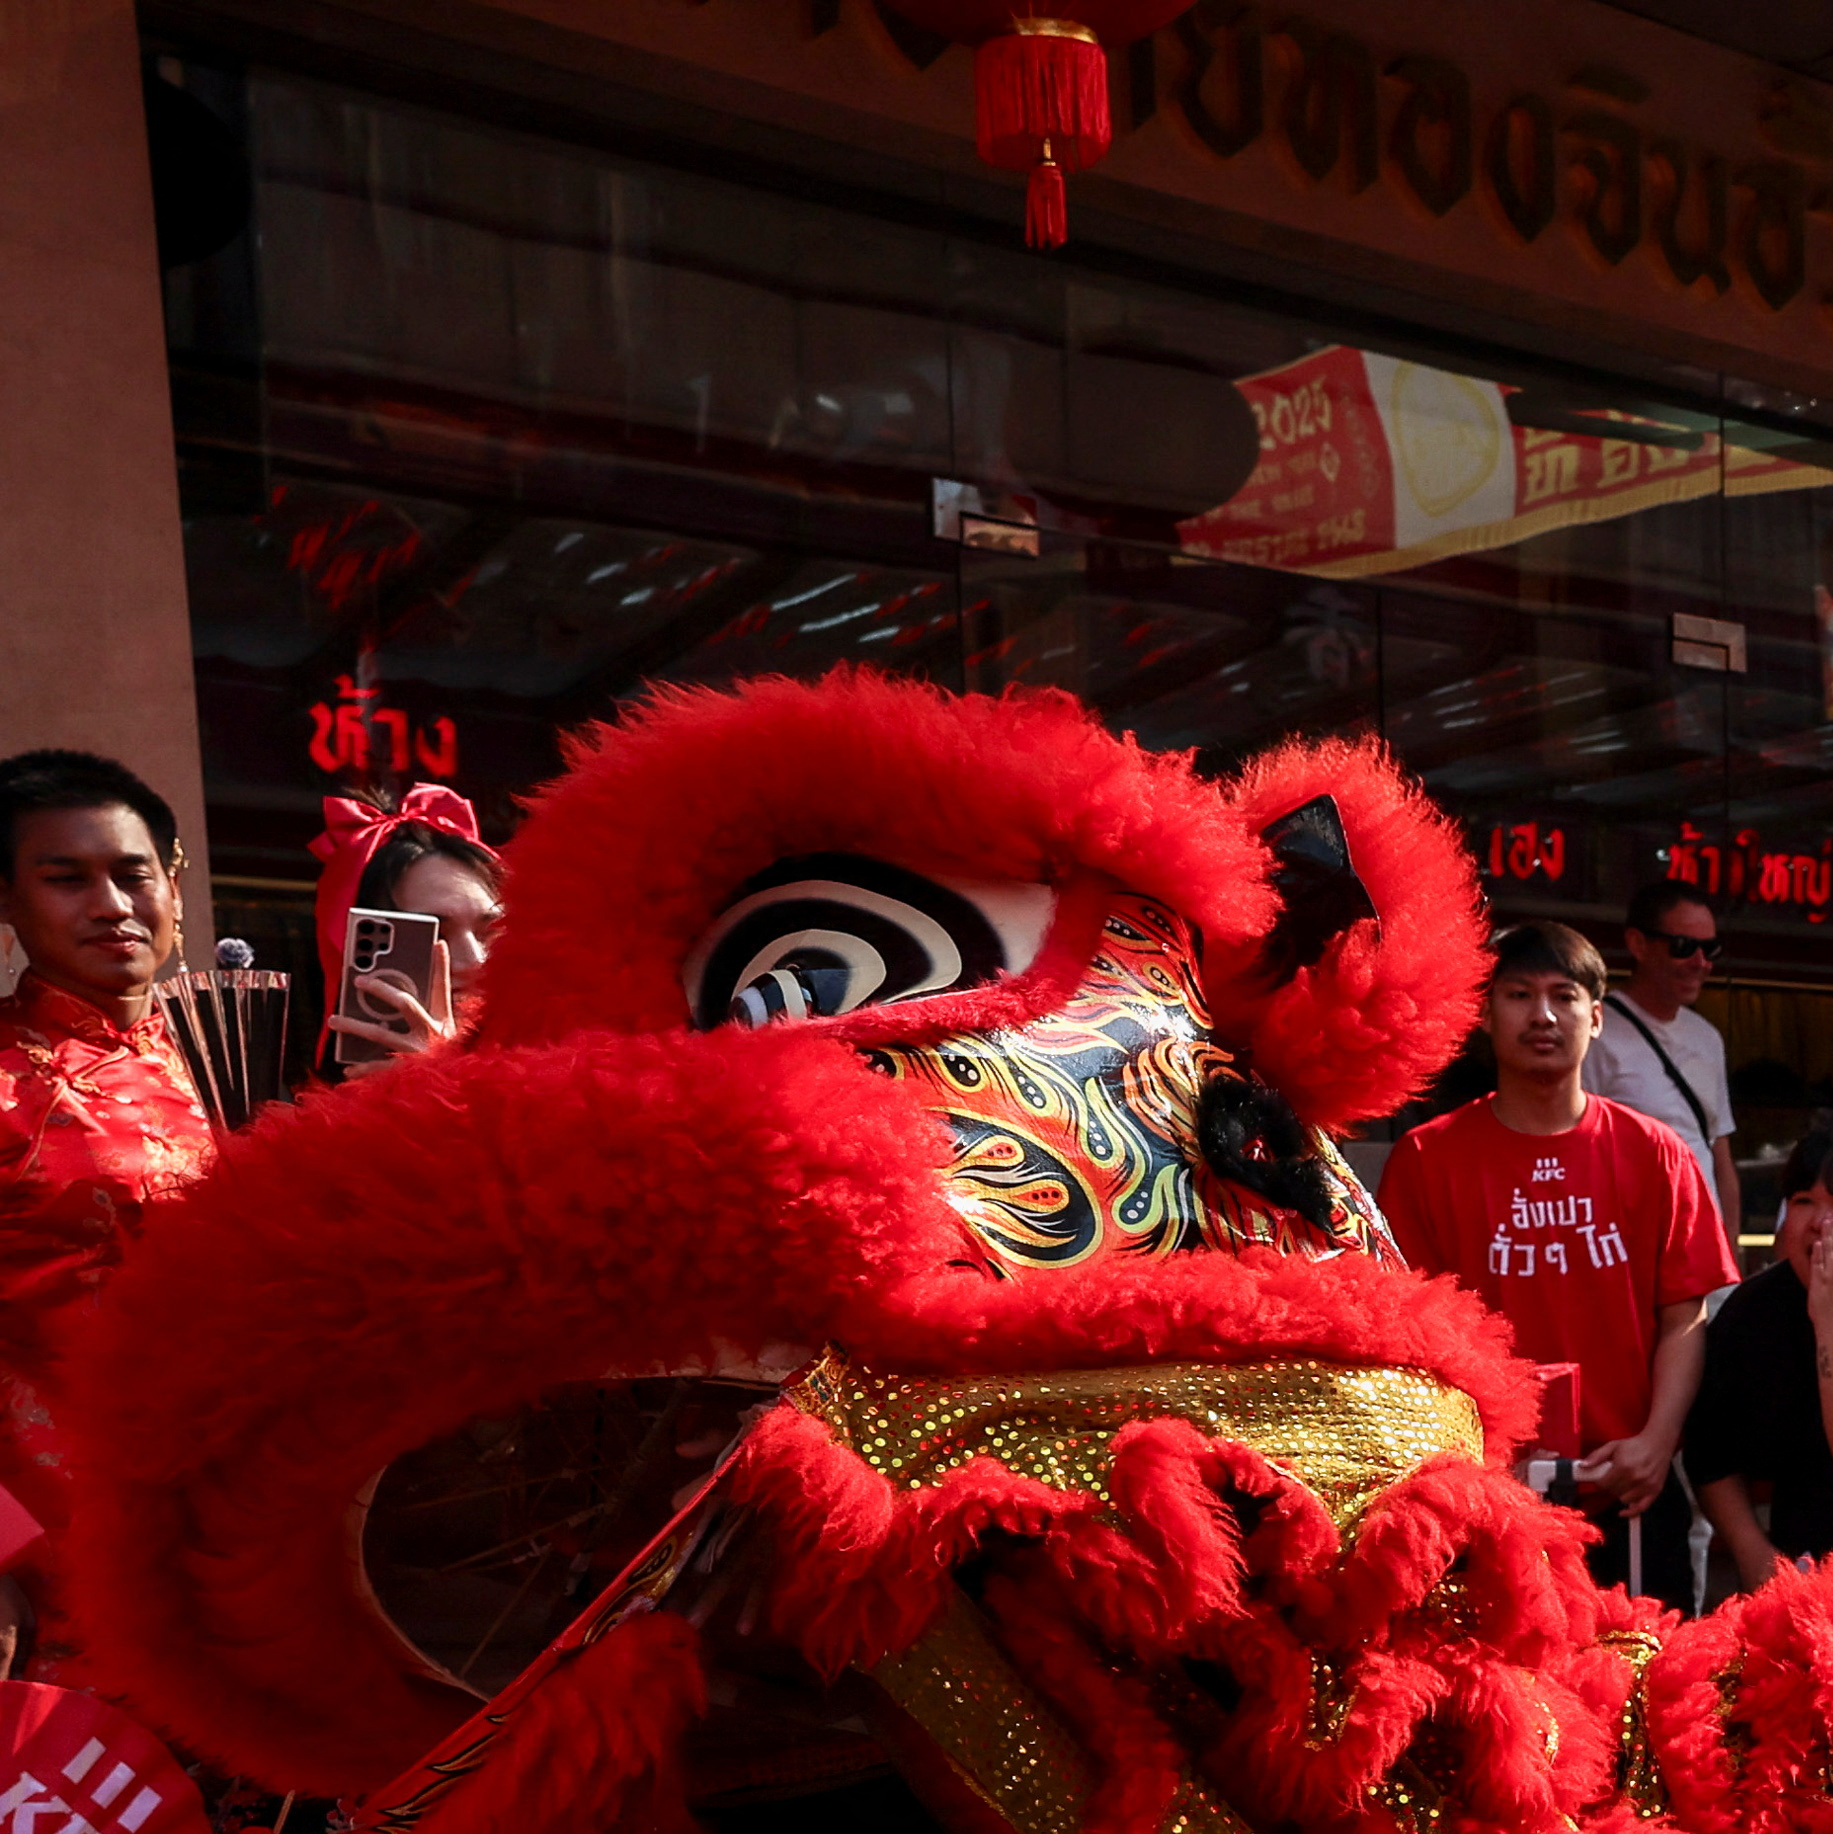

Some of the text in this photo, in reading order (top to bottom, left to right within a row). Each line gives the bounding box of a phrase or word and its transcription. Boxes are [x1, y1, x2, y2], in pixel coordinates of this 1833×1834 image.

[308, 670, 458, 777] ห้าง
[1531, 1167, 1567, 1182] KFC
[1511, 1187, 1593, 1229] อั่งเปา
[1576, 1222, 1628, 1269] ไก่
